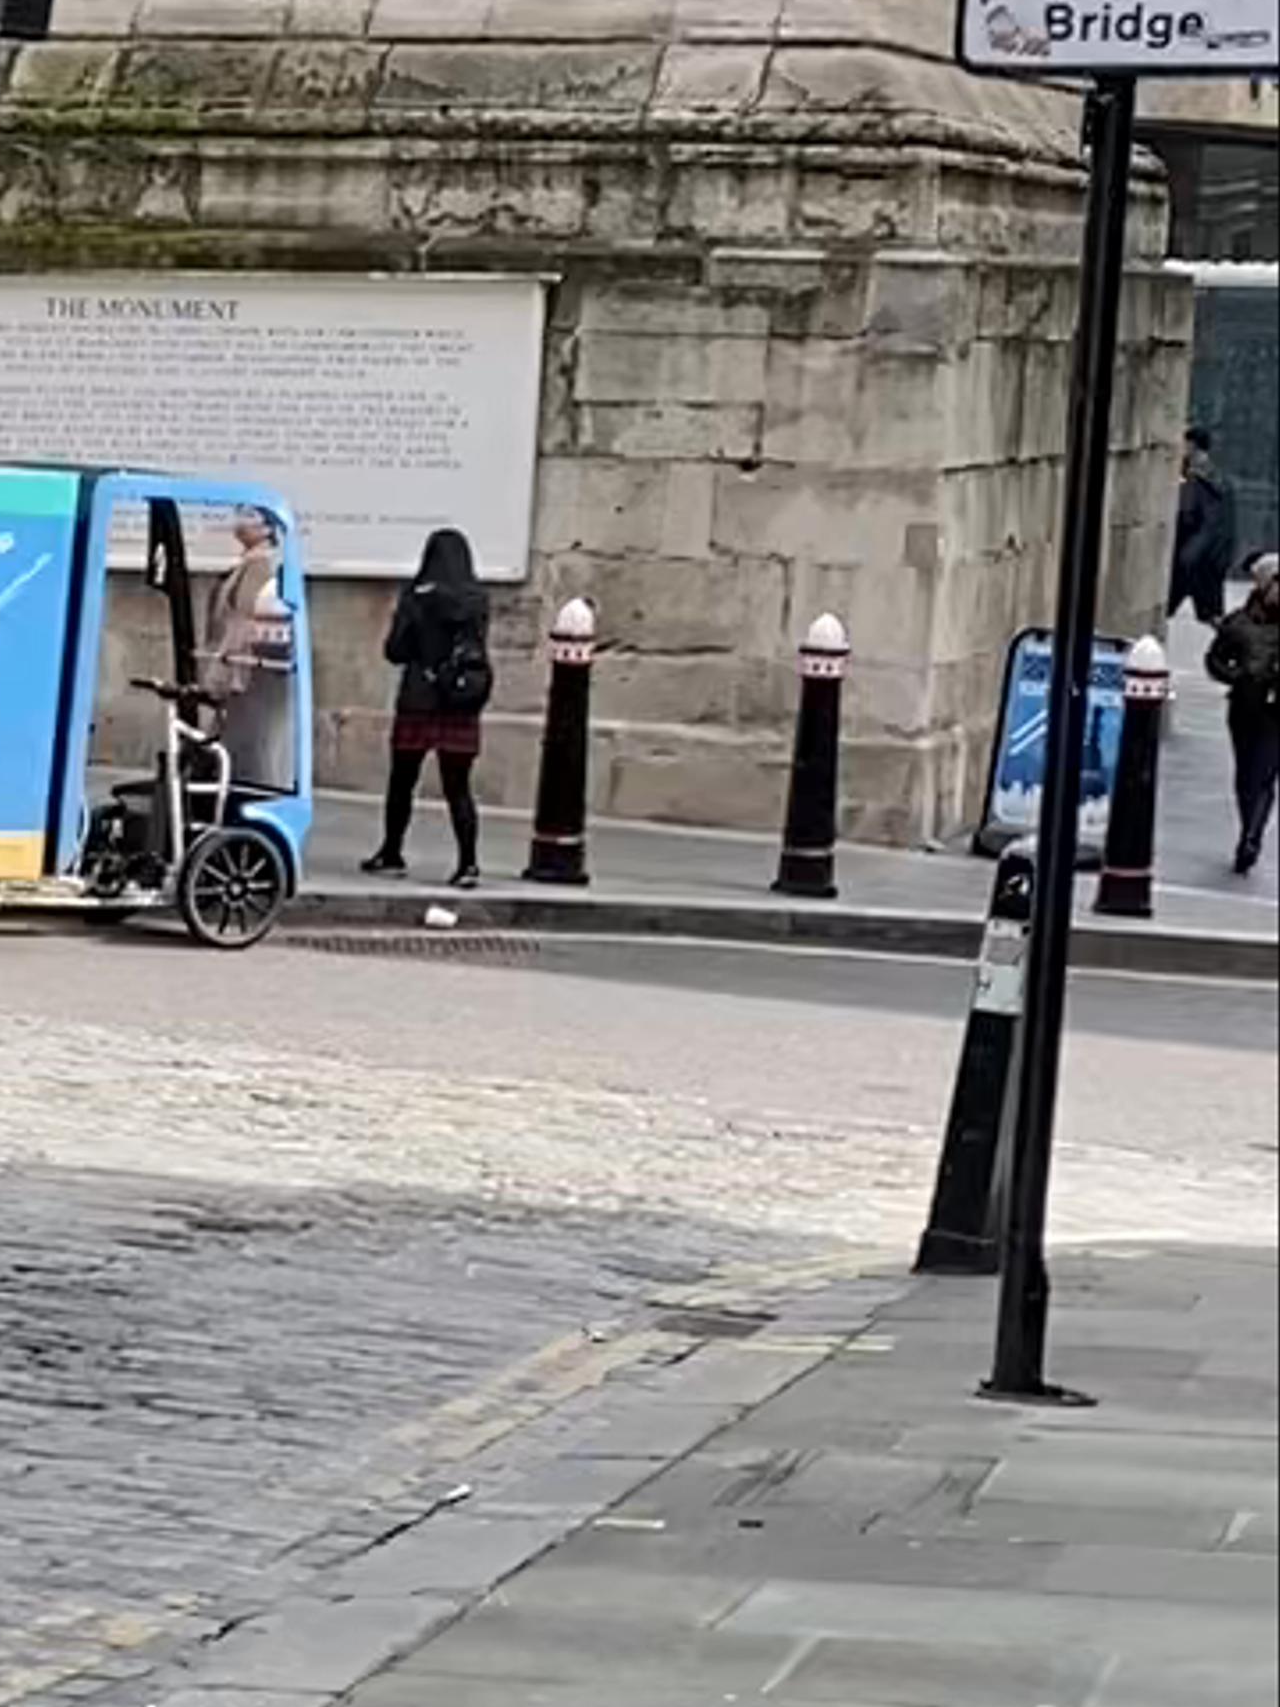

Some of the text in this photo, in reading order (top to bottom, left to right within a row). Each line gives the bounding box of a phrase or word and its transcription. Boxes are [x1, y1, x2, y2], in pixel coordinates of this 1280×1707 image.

[1044, 3, 1204, 50] Bridge
[45, 296, 240, 321] THE MONUMENT
